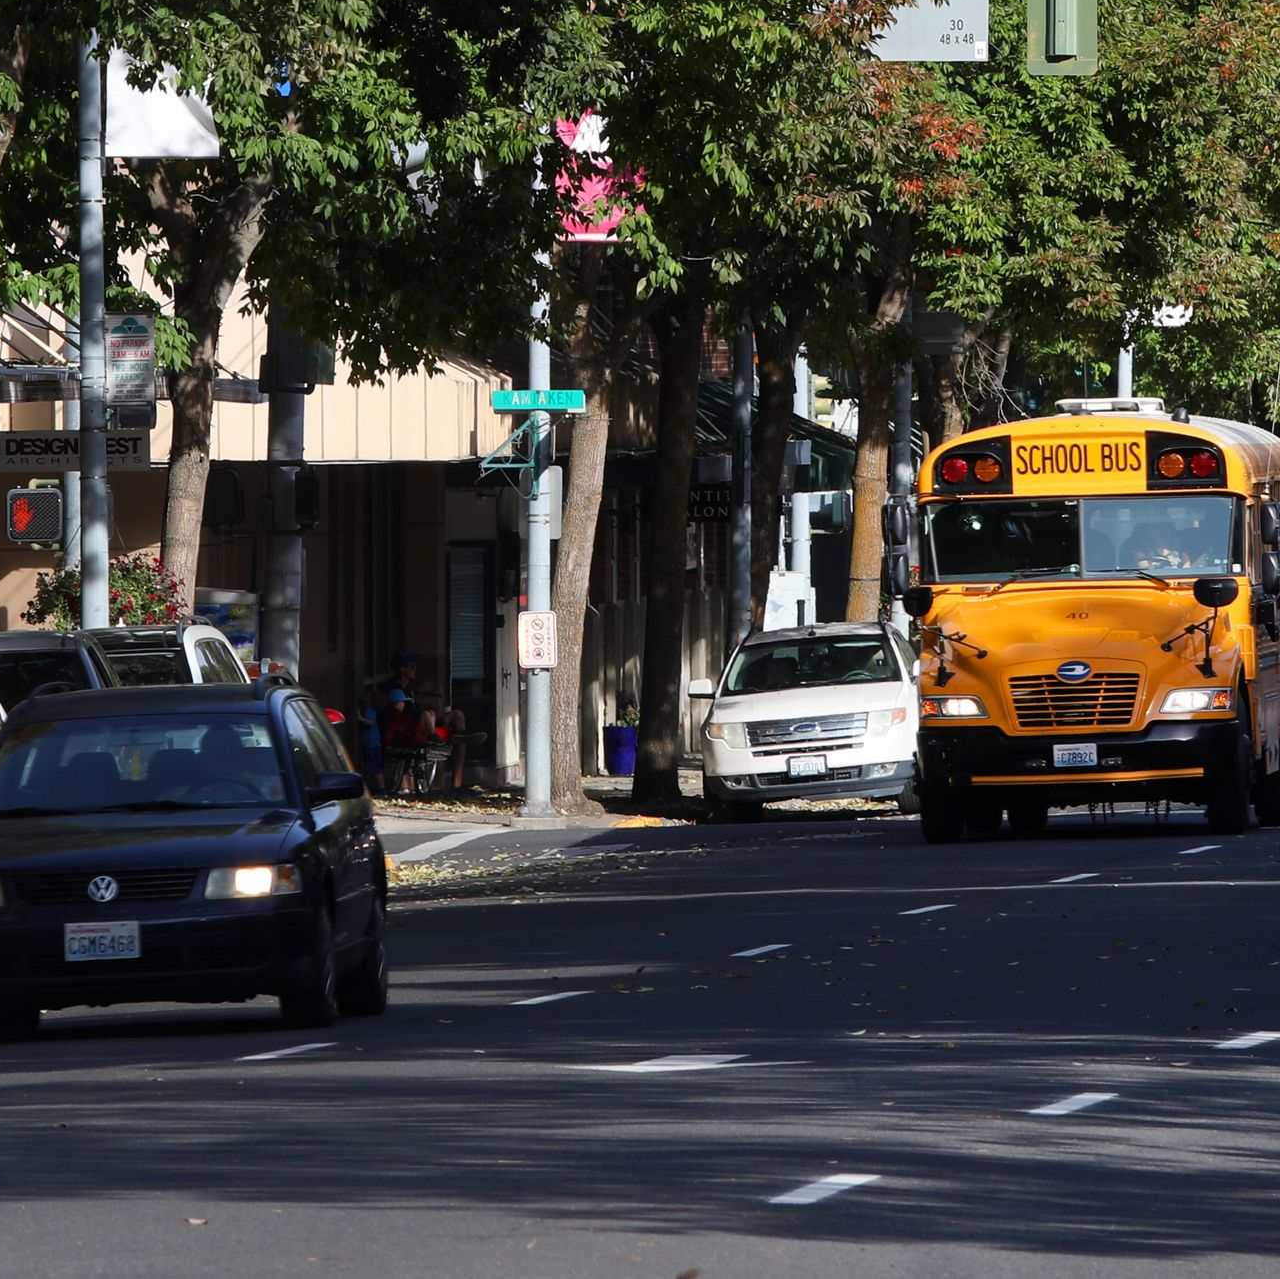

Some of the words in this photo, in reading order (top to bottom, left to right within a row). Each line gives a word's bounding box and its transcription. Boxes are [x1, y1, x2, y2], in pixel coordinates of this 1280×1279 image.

[949, 19, 964, 31] 30
[940, 33, 951, 44] 48
[962, 33, 975, 44] 48
[111, 339, 121, 348] NO
[122, 338, 150, 348] PARKING
[503, 391, 574, 405] KAMIAKEN
[5, 438, 78, 456] DESIGN
[106, 437, 143, 455] EST
[6, 456, 143, 465] ARCHITS
[1015, 444, 1095, 475] SCHOOL
[1100, 442, 1142, 472] BUS
